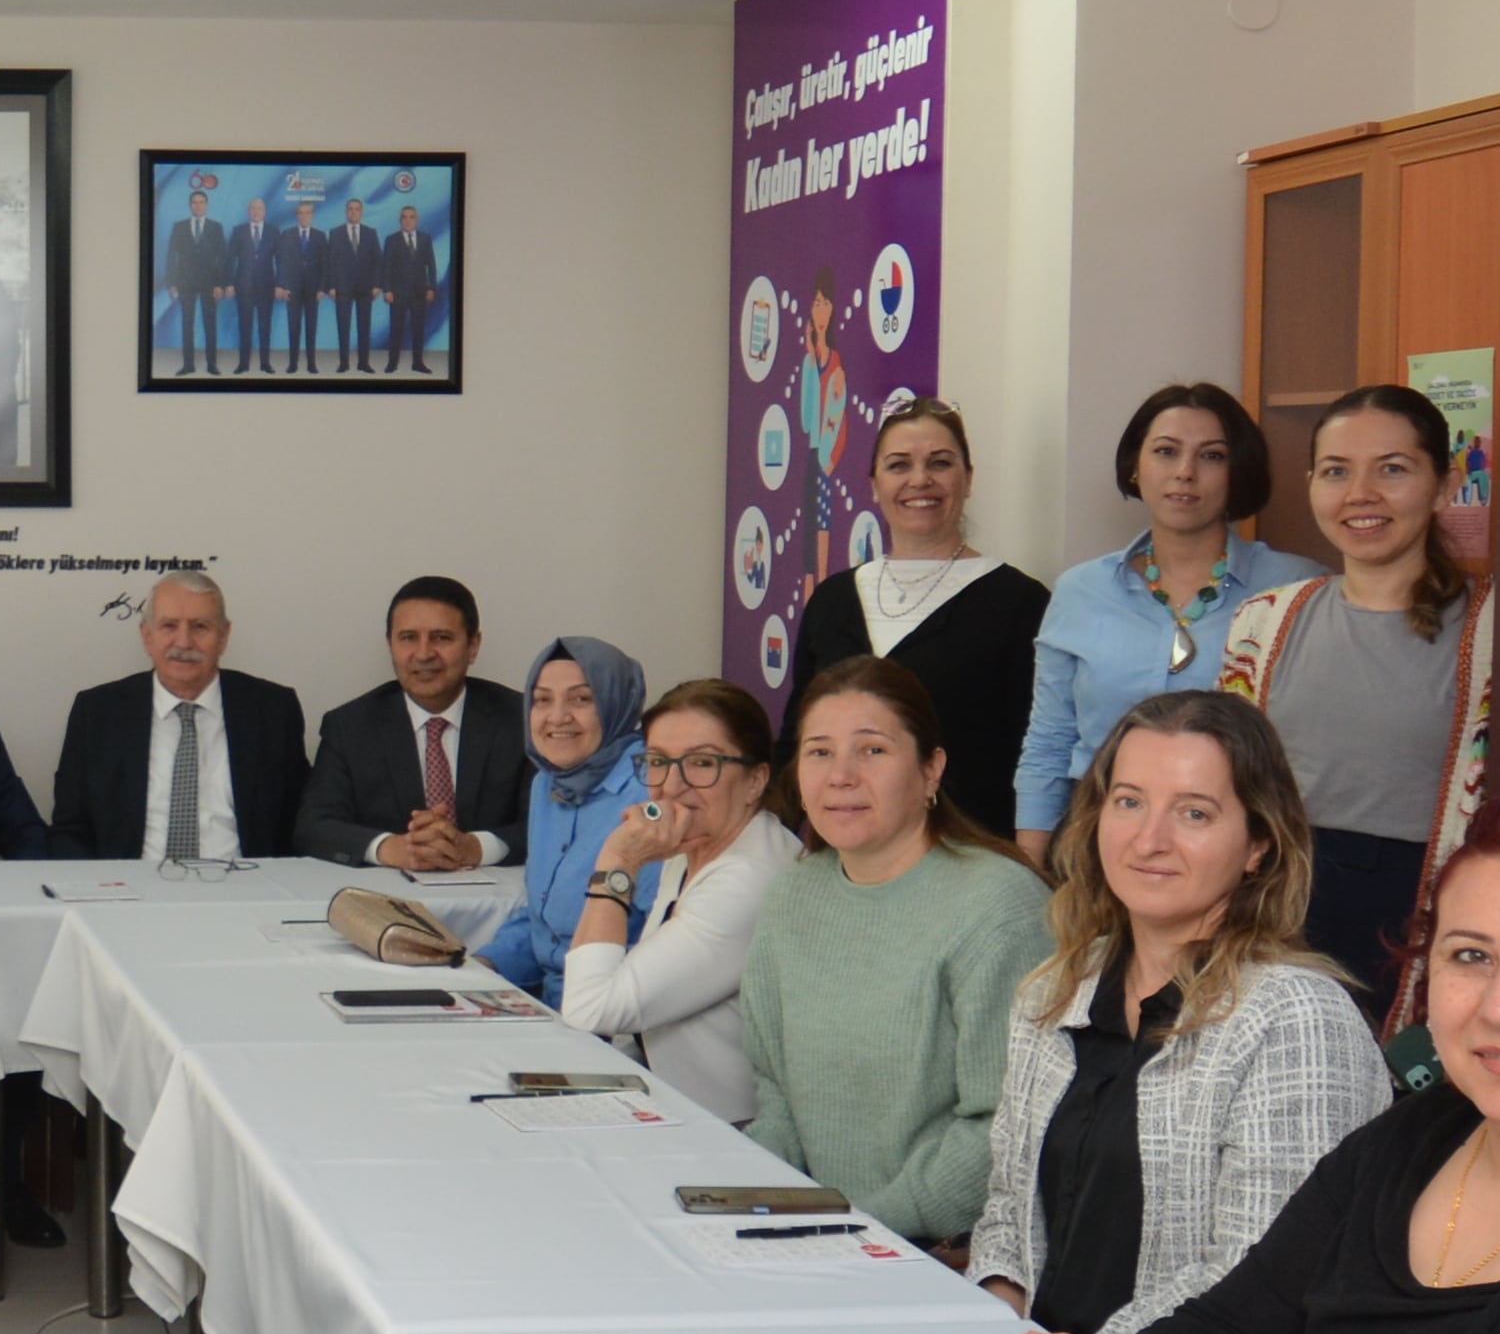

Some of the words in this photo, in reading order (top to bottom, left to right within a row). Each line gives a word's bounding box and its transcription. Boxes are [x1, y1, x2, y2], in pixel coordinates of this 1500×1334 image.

[745, 82, 797, 140] Çalışır,
[800, 51, 851, 111] üretir,
[854, 15, 934, 102] güçlenir
[744, 148, 802, 214] Kadın
[805, 138, 845, 196] her
[846, 98, 931, 200] yerde!
[49, 554, 141, 575] yükselmeye
